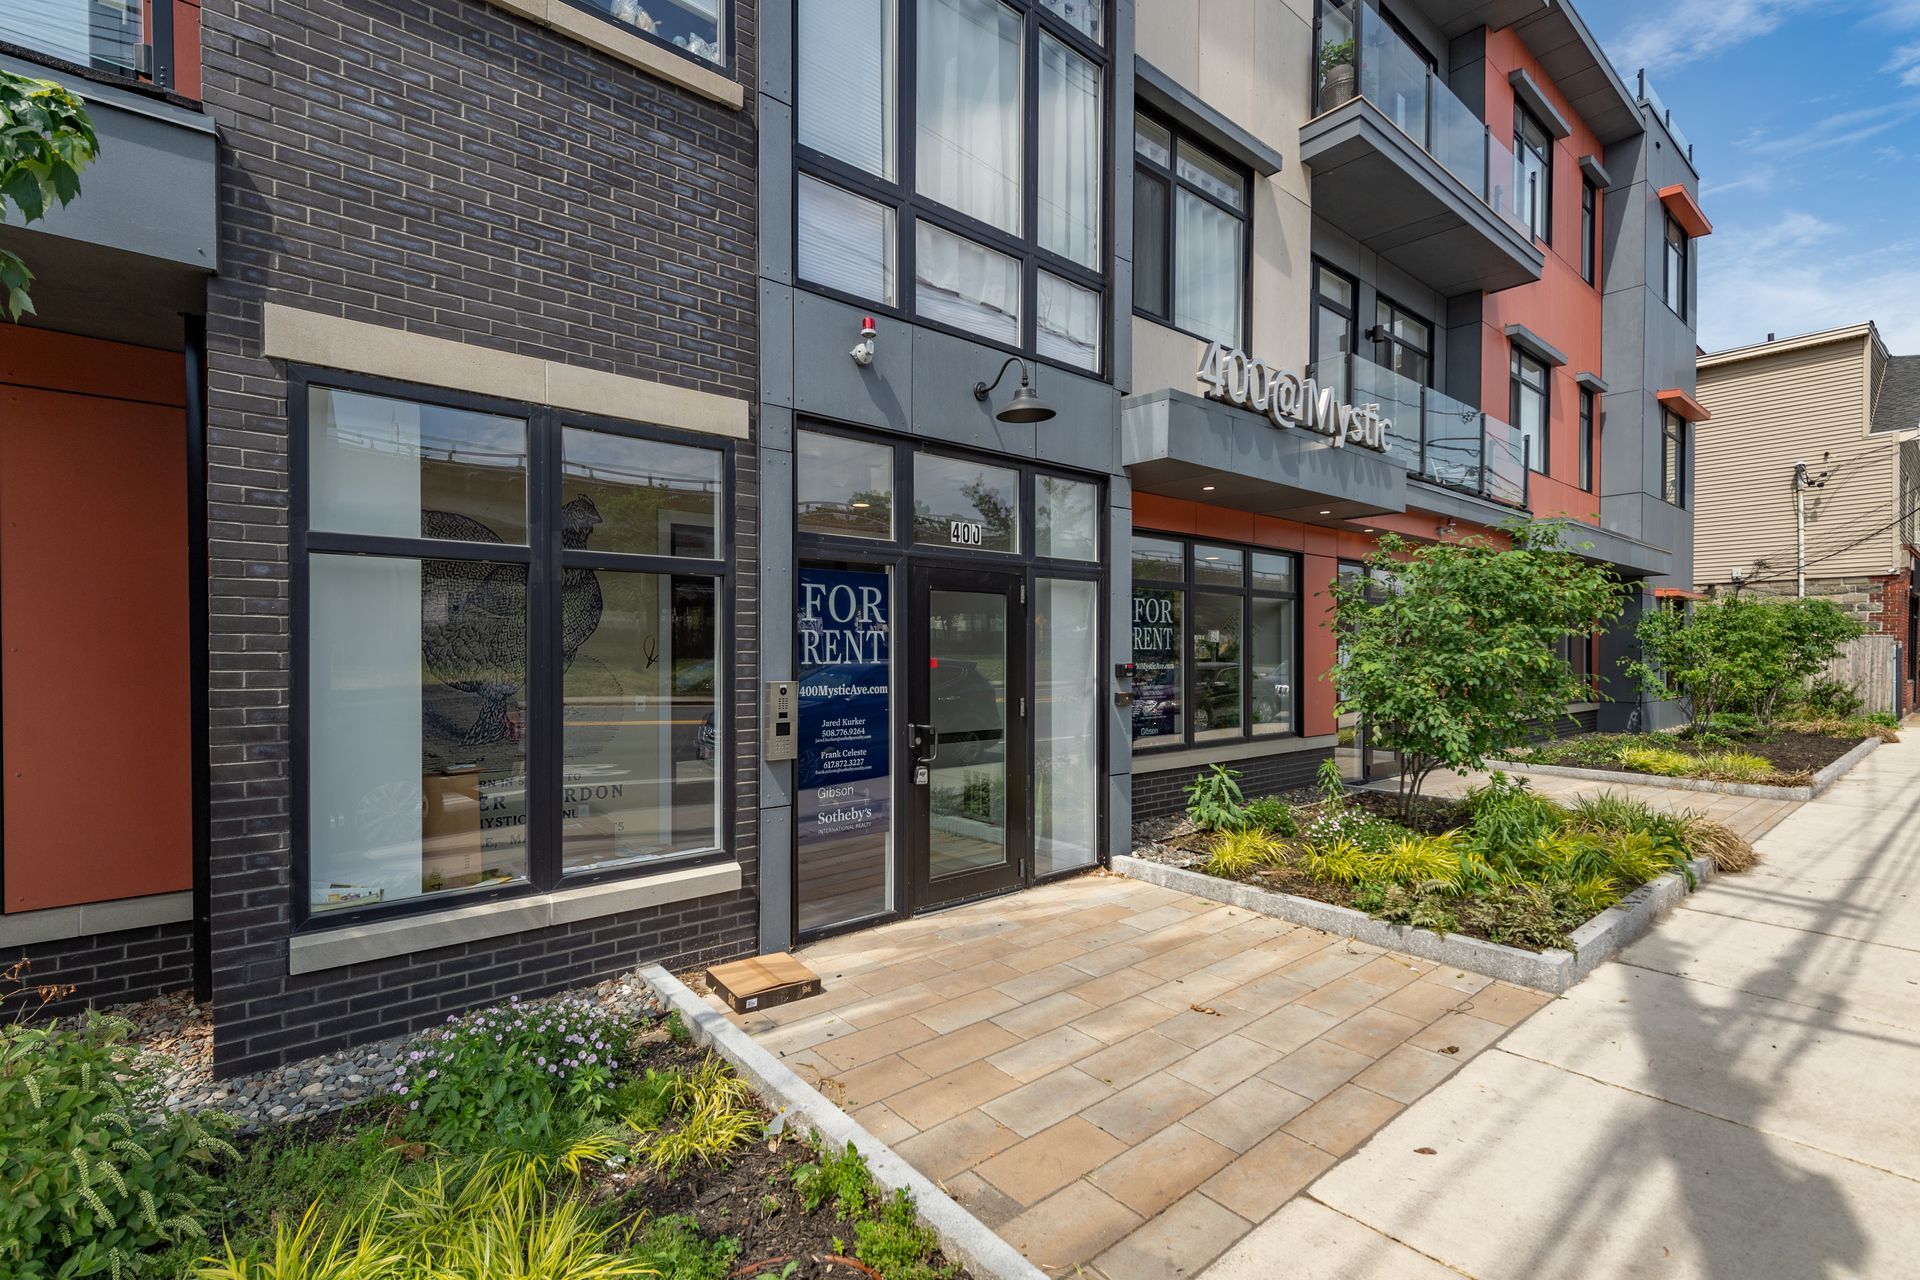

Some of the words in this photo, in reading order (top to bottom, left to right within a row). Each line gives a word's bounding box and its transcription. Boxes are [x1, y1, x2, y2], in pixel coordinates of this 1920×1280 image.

[1196, 340, 1393, 450] 400@Mystic
[952, 523, 980, 544] 400
[801, 583, 886, 623] FOR
[1133, 598, 1173, 624] FOR
[801, 629, 885, 665] RENT
[1133, 627, 1173, 650] RENT
[799, 684, 888, 699] 400MysticAve.com
[821, 719, 841, 728] Jared
[842, 717, 866, 726] Kurker
[821, 727, 866, 738] 508.776.9264
[820, 749, 842, 760] Frank
[842, 748, 867, 758] Celeste
[817, 785, 854, 799] Gibson
[817, 807, 872, 825] Sotheby's
[817, 824, 855, 835] INTERNATIONAL
[855, 821, 872, 829] REALTY
